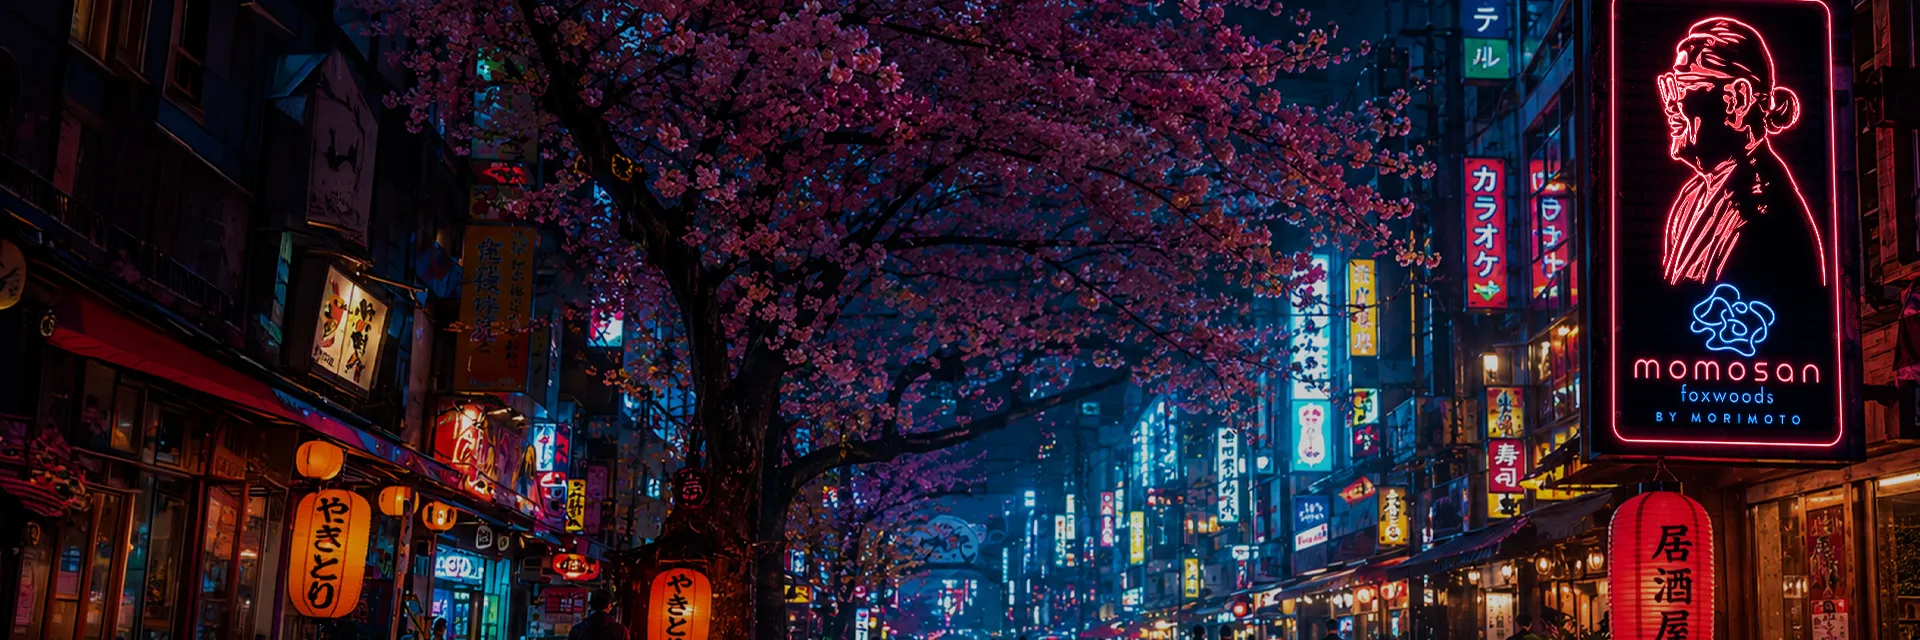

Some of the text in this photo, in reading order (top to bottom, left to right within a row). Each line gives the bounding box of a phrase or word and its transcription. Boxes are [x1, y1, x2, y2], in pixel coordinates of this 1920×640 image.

[1473, 166, 1499, 278] カラオケ
[1634, 359, 1820, 383] momosan
[1680, 384, 1774, 404] foxwoods
[1655, 411, 1801, 425] BY MORIMOTO
[1494, 443, 1520, 488] 寿司
[307, 497, 349, 609] やきとり
[666, 573, 693, 640] やきと
[1651, 524, 1693, 640] 居酒屋
